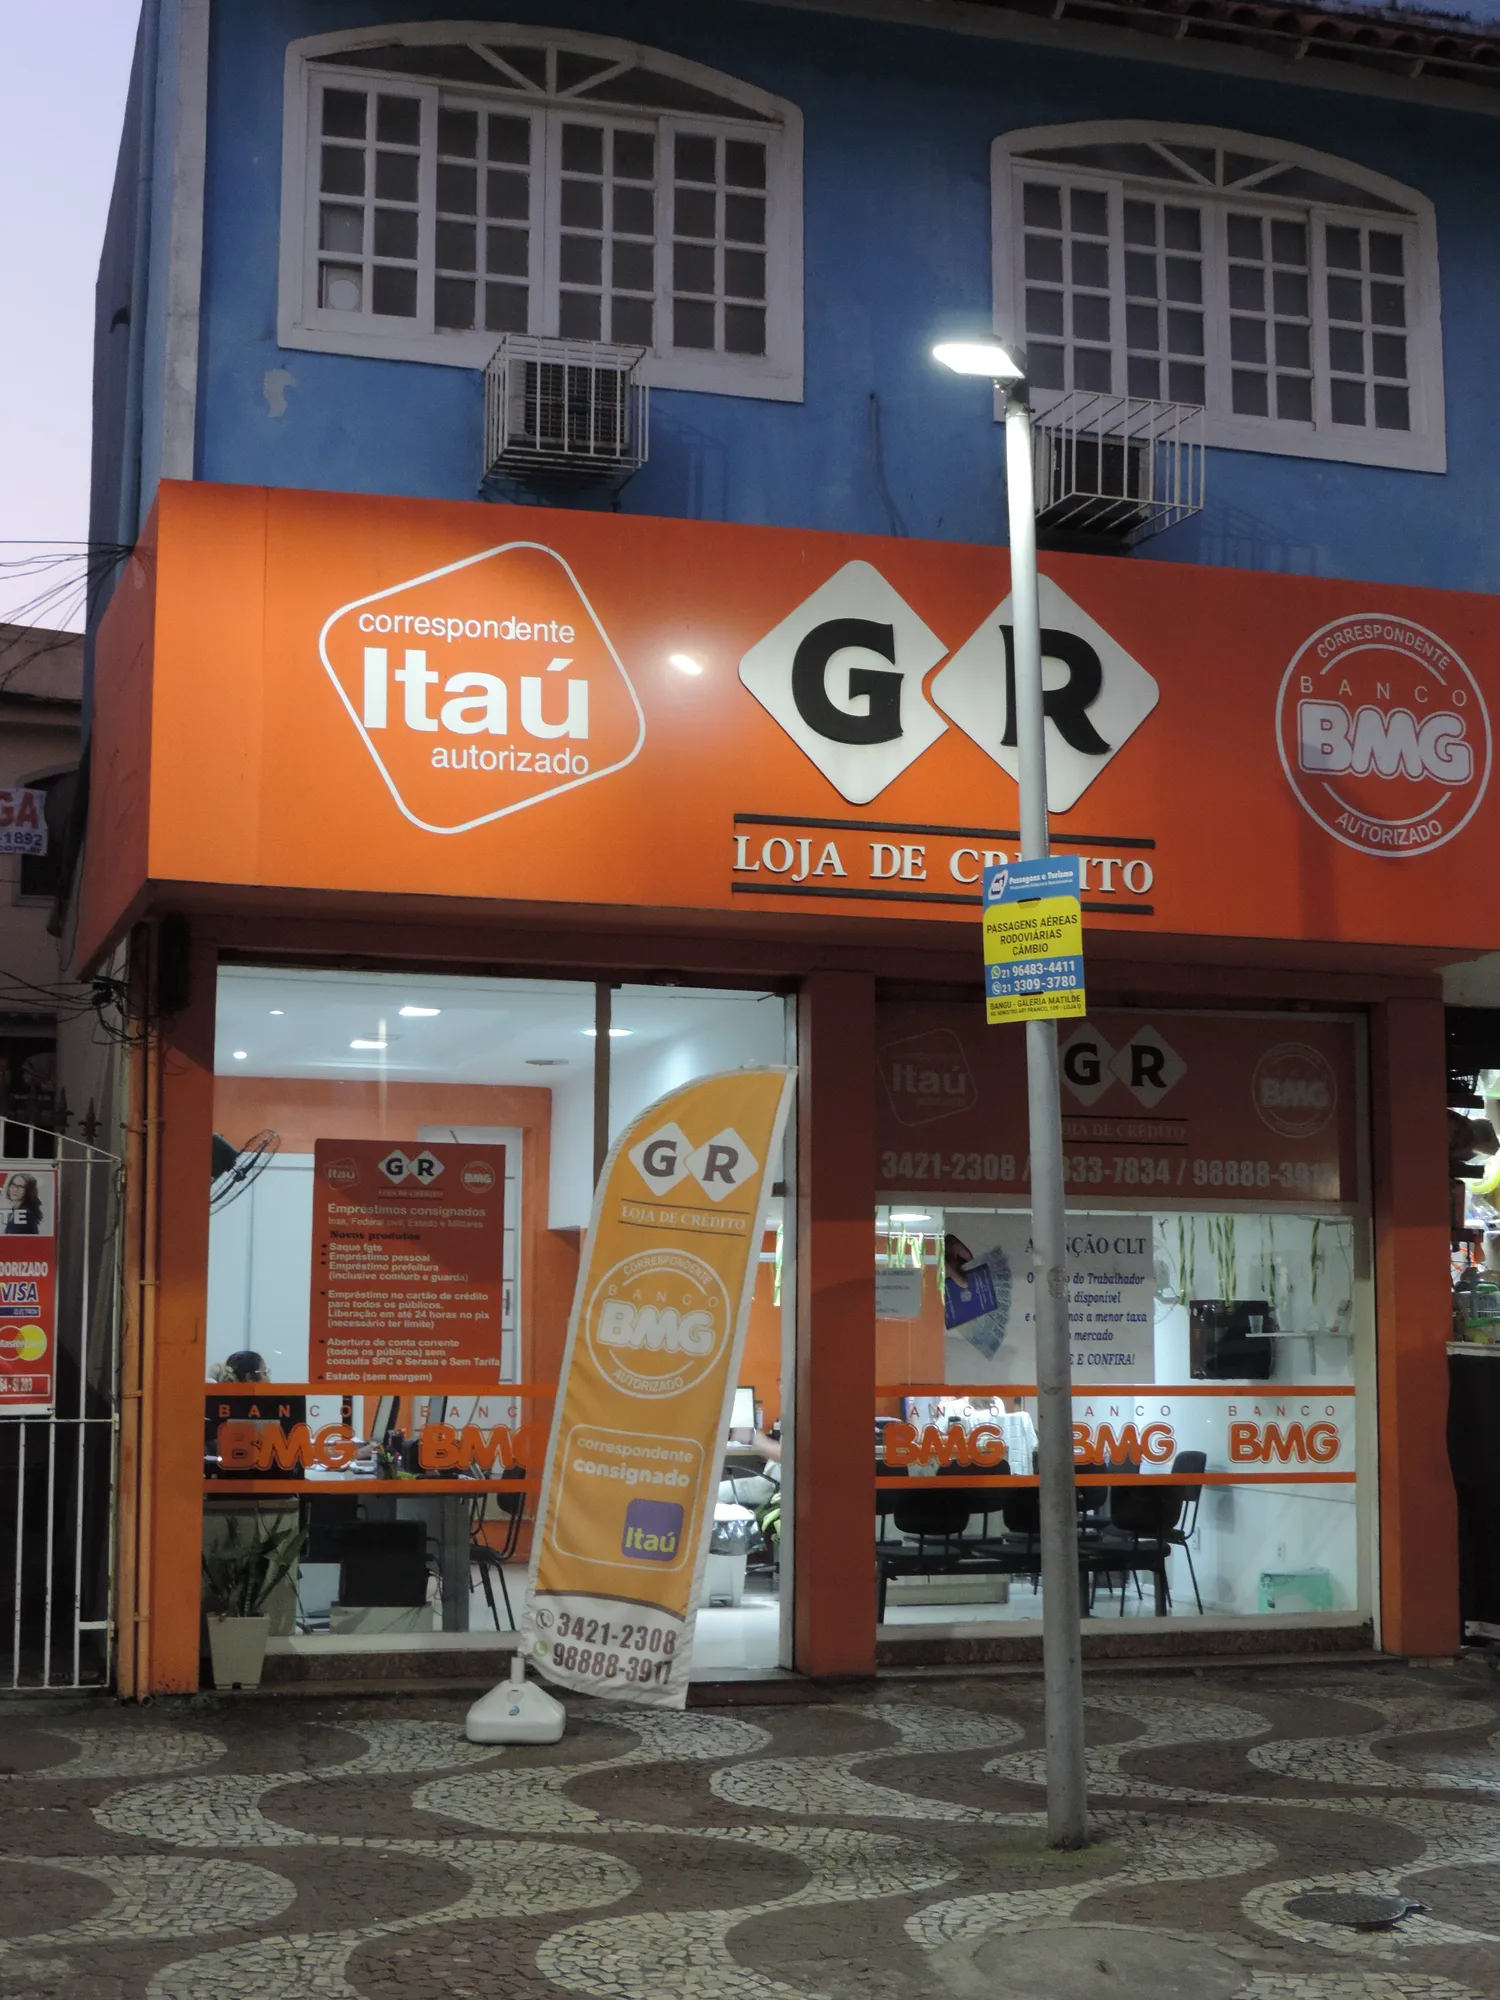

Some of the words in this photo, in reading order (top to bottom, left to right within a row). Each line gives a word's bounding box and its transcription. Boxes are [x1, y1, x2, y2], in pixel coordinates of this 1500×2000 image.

[359, 613, 575, 643] correspondente
[1317, 624, 1450, 671] CORRESPONDENTE
[364, 647, 589, 739] Itaú
[1300, 676, 1467, 707] BANCO
[1297, 698, 1473, 785] BMG
[431, 745, 589, 775] autorizado
[1336, 812, 1442, 845] AUTORIZADO
[733, 836, 847, 882] LOJA
[869, 843, 926, 880] DE
[1047, 870, 1073, 880] Turismo
[987, 919, 1037, 934] PASSAGENS
[1040, 914, 1078, 927] AÉREAS
[1000, 929, 1062, 944] RODOVIÁRIAS
[1012, 943, 1048, 956] CÂMBIO
[1001, 970, 1010, 978] 21
[1012, 960, 1075, 976] 96483-4411
[1002, 985, 1011, 993] 21
[1014, 975, 1076, 992] 3309-3780
[990, 1001, 1012, 1010] BANGU
[1018, 997, 1046, 1007] GALERIA
[1048, 994, 1081, 1004] MATILDE
[892, 1063, 967, 1095] Itaú
[1261, 1078, 1330, 1108] BMG
[881, 1151, 1016, 1181] 3421-2308
[328, 1203, 407, 1216] Empréstimos
[410, 1206, 486, 1218] consignados
[621, 1206, 656, 1223] LOJA
[659, 1212, 678, 1224] DE
[681, 1214, 746, 1231] CRÉDITO
[351, 1217, 384, 1226] Federal
[329, 1243, 361, 1252] Saque
[1025, 1234, 1109, 1257] AÇÃO
[1114, 1237, 1147, 1255] CLT
[329, 1252, 389, 1263] Empréstimo
[392, 1254, 430, 1264] pessoal
[329, 1261, 389, 1272] Empréstimo
[391, 1263, 439, 1273] prefeitura
[328, 1271, 376, 1281] (inclusive
[431, 1273, 468, 1283] guarda)
[623, 1255, 713, 1285] CORRESPONDENTE
[1027, 1272, 1034, 1283] O
[1073, 1273, 1084, 1284] do
[1087, 1273, 1146, 1285] Trabalhador
[1, 1283, 38, 1302] VISA
[328, 1290, 388, 1301] Empréstimo
[391, 1292, 403, 1300] no
[406, 1291, 437, 1301] cartão
[440, 1291, 451, 1300] de
[454, 1291, 489, 1301] crédito
[608, 1284, 719, 1308] BANCO
[328, 1301, 350, 1310] para
[353, 1300, 381, 1309] todos
[384, 1301, 396, 1309] os
[328, 1309, 377, 1320] Liberação
[397, 1310, 412, 1319] até
[414, 1311, 427, 1319] 24
[429, 1310, 457, 1320] horas
[460, 1312, 472, 1320] no
[475, 1311, 490, 1321] pix
[328, 1319, 386, 1329] (necessário
[388, 1320, 402, 1328] ter
[1025, 1313, 1031, 1322] e
[1087, 1313, 1093, 1322] a
[1096, 1313, 1124, 1322] menor
[1126, 1312, 1148, 1322] taxa
[597, 1299, 716, 1358] BMG
[1075, 1329, 1114, 1341] mercado
[327, 1338, 370, 1347] Abertura
[373, 1338, 385, 1347] de
[388, 1339, 416, 1347] conta
[418, 1340, 460, 1348] corrente
[327, 1347, 359, 1357] (todos
[361, 1348, 374, 1356] os
[425, 1349, 446, 1357] sem
[327, 1357, 369, 1366] consulta
[372, 1357, 394, 1366] SPC
[405, 1358, 439, 1367] Serasa
[441, 1359, 448, 1367] e
[450, 1358, 471, 1367] Sem
[1087, 1353, 1135, 1365] CONFIRA!
[325, 1372, 361, 1381] Estado
[363, 1372, 387, 1382] (sem
[389, 1373, 433, 1383] margem)
[612, 1369, 684, 1392] AUTORIZADO
[219, 1404, 352, 1417] BANCO
[910, 1405, 999, 1418] ANCO
[1085, 1405, 1171, 1417] ANCO
[1228, 1405, 1335, 1417] BANCO
[217, 1422, 358, 1471] BMG
[577, 1436, 694, 1463] correspondente
[883, 1422, 1007, 1467] BMG
[1229, 1421, 1342, 1464] BMG
[573, 1458, 690, 1487] consignado
[625, 1527, 677, 1553] Itaú
[557, 1612, 677, 1655] 3421-2308
[553, 1643, 673, 1685] 98888-3917
